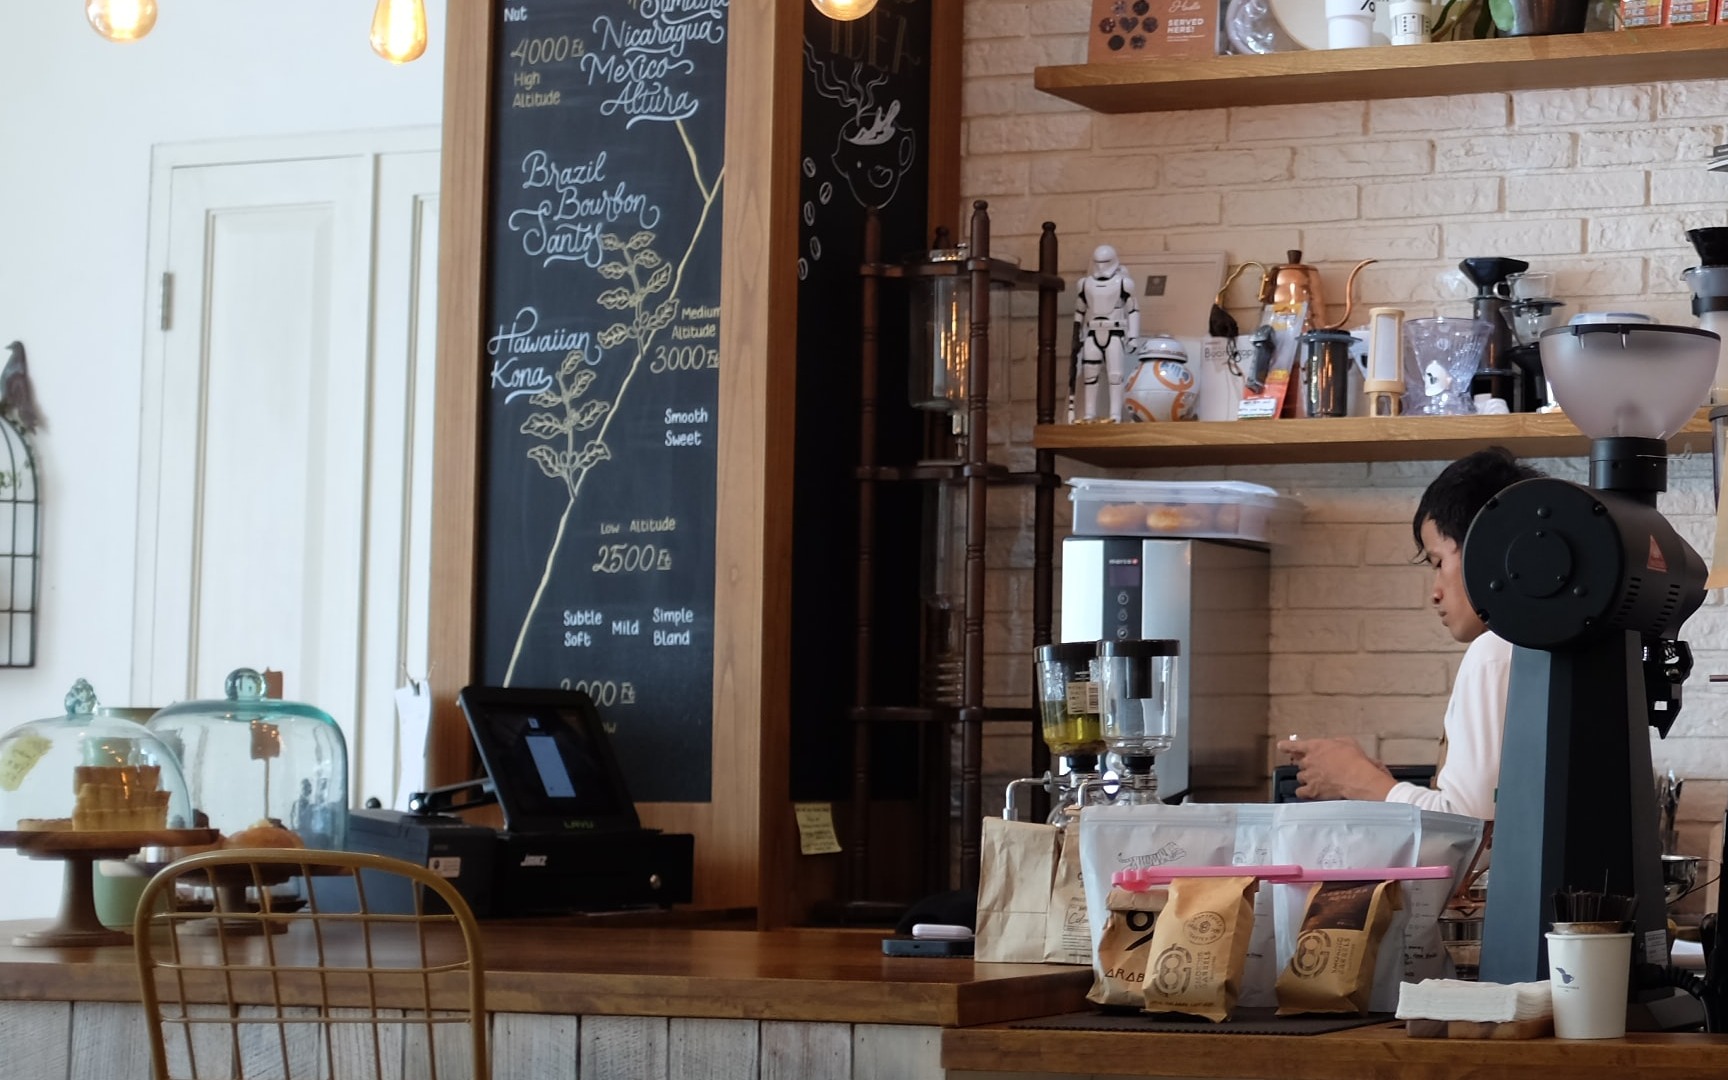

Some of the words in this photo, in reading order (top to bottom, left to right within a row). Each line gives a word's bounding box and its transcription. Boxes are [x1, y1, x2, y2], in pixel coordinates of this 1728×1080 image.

[504, 7, 527, 22] Nut
[593, 15, 724, 57] Nicaragua
[510, 36, 569, 67] 4000
[581, 53, 694, 86] Mexico
[514, 72, 541, 91] High
[512, 90, 561, 108] Altitude
[600, 81, 699, 130] Altura
[522, 150, 607, 193] Brazil
[553, 182, 660, 229] Bourbon
[508, 200, 602, 268] Santos
[487, 307, 602, 365] Hawaiian
[671, 324, 716, 340] Altitude
[650, 345, 706, 374] 3000
[491, 357, 553, 405] Kona
[665, 407, 709, 424] Smooth
[665, 430, 702, 447] Sweet
[601, 523, 621, 535] Low
[629, 516, 676, 532] Altitude
[592, 543, 655, 573] 2500
[563, 610, 602, 626] Subtle
[652, 607, 694, 626] Simple
[612, 620, 640, 635] Mild
[564, 631, 591, 647] Soft
[653, 630, 690, 646] Bland
